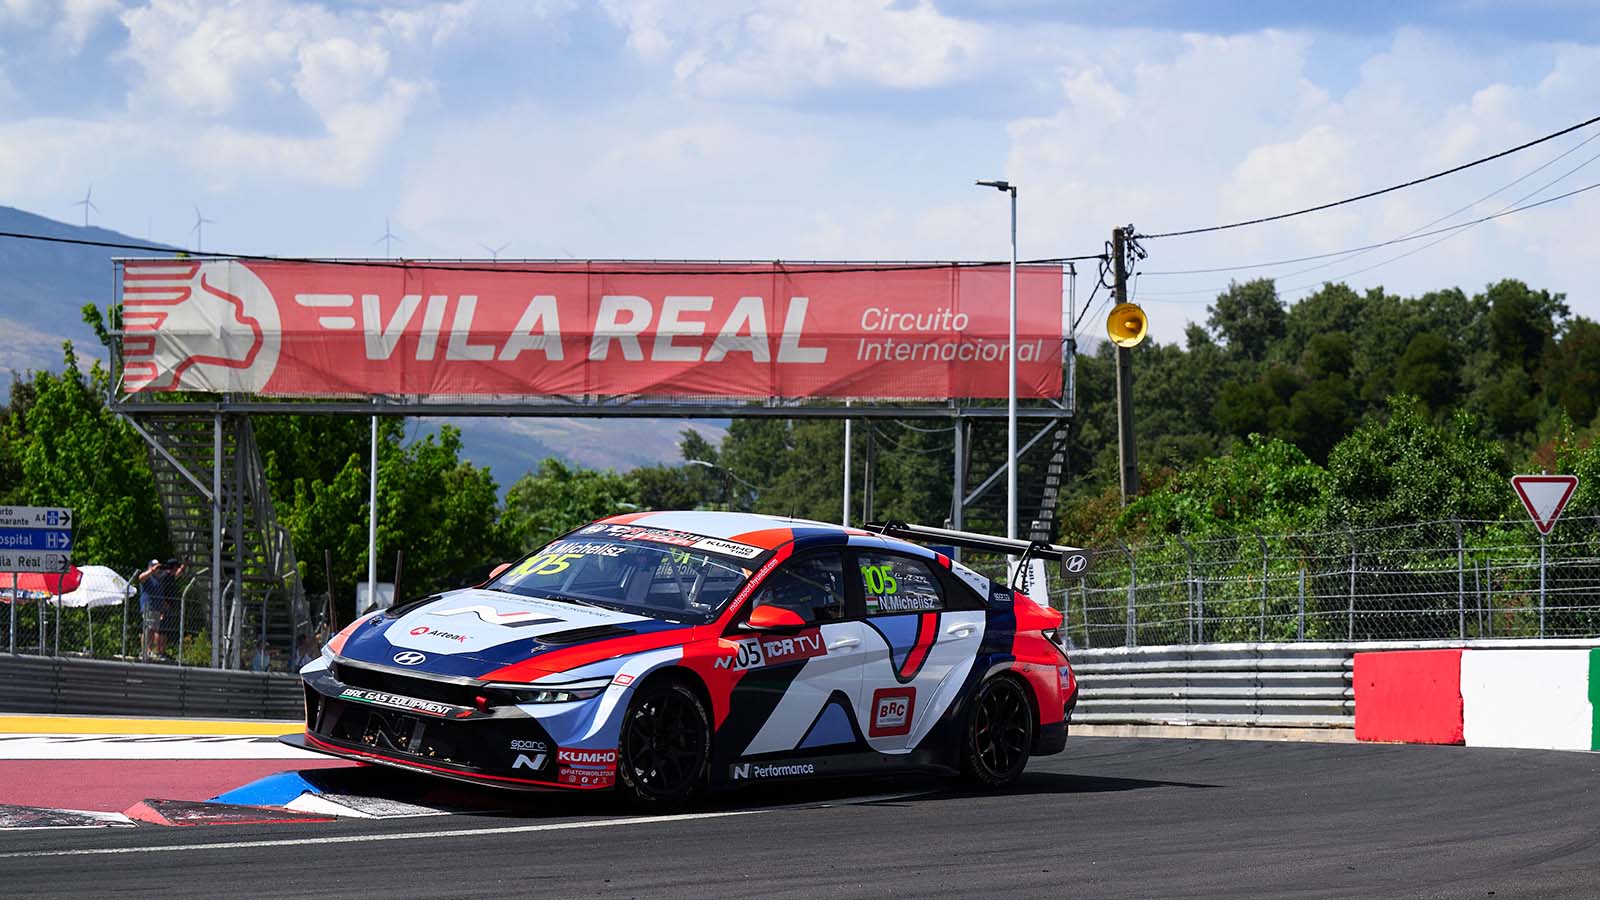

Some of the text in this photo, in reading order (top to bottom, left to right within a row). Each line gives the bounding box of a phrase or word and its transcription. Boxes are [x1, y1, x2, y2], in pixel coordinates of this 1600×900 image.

[860, 307, 969, 332] Circuito
[361, 295, 828, 363] VILA REAL
[0, 508, 13, 516] rto
[705, 540, 754, 554] KUMHO
[18, 555, 41, 567] Real
[730, 558, 778, 613] motorsport.hyundai.com
[860, 565, 898, 595] 105
[880, 596, 936, 611] N.Michelisz
[427, 629, 468, 643] Arteak
[763, 634, 820, 658] TCR TV
[736, 642, 761, 668] 05
[341, 688, 453, 715] BRC GAS EQUIPMENT
[880, 702, 905, 718] BRC
[559, 751, 616, 763] KUMHO
[754, 763, 815, 779] Performance
